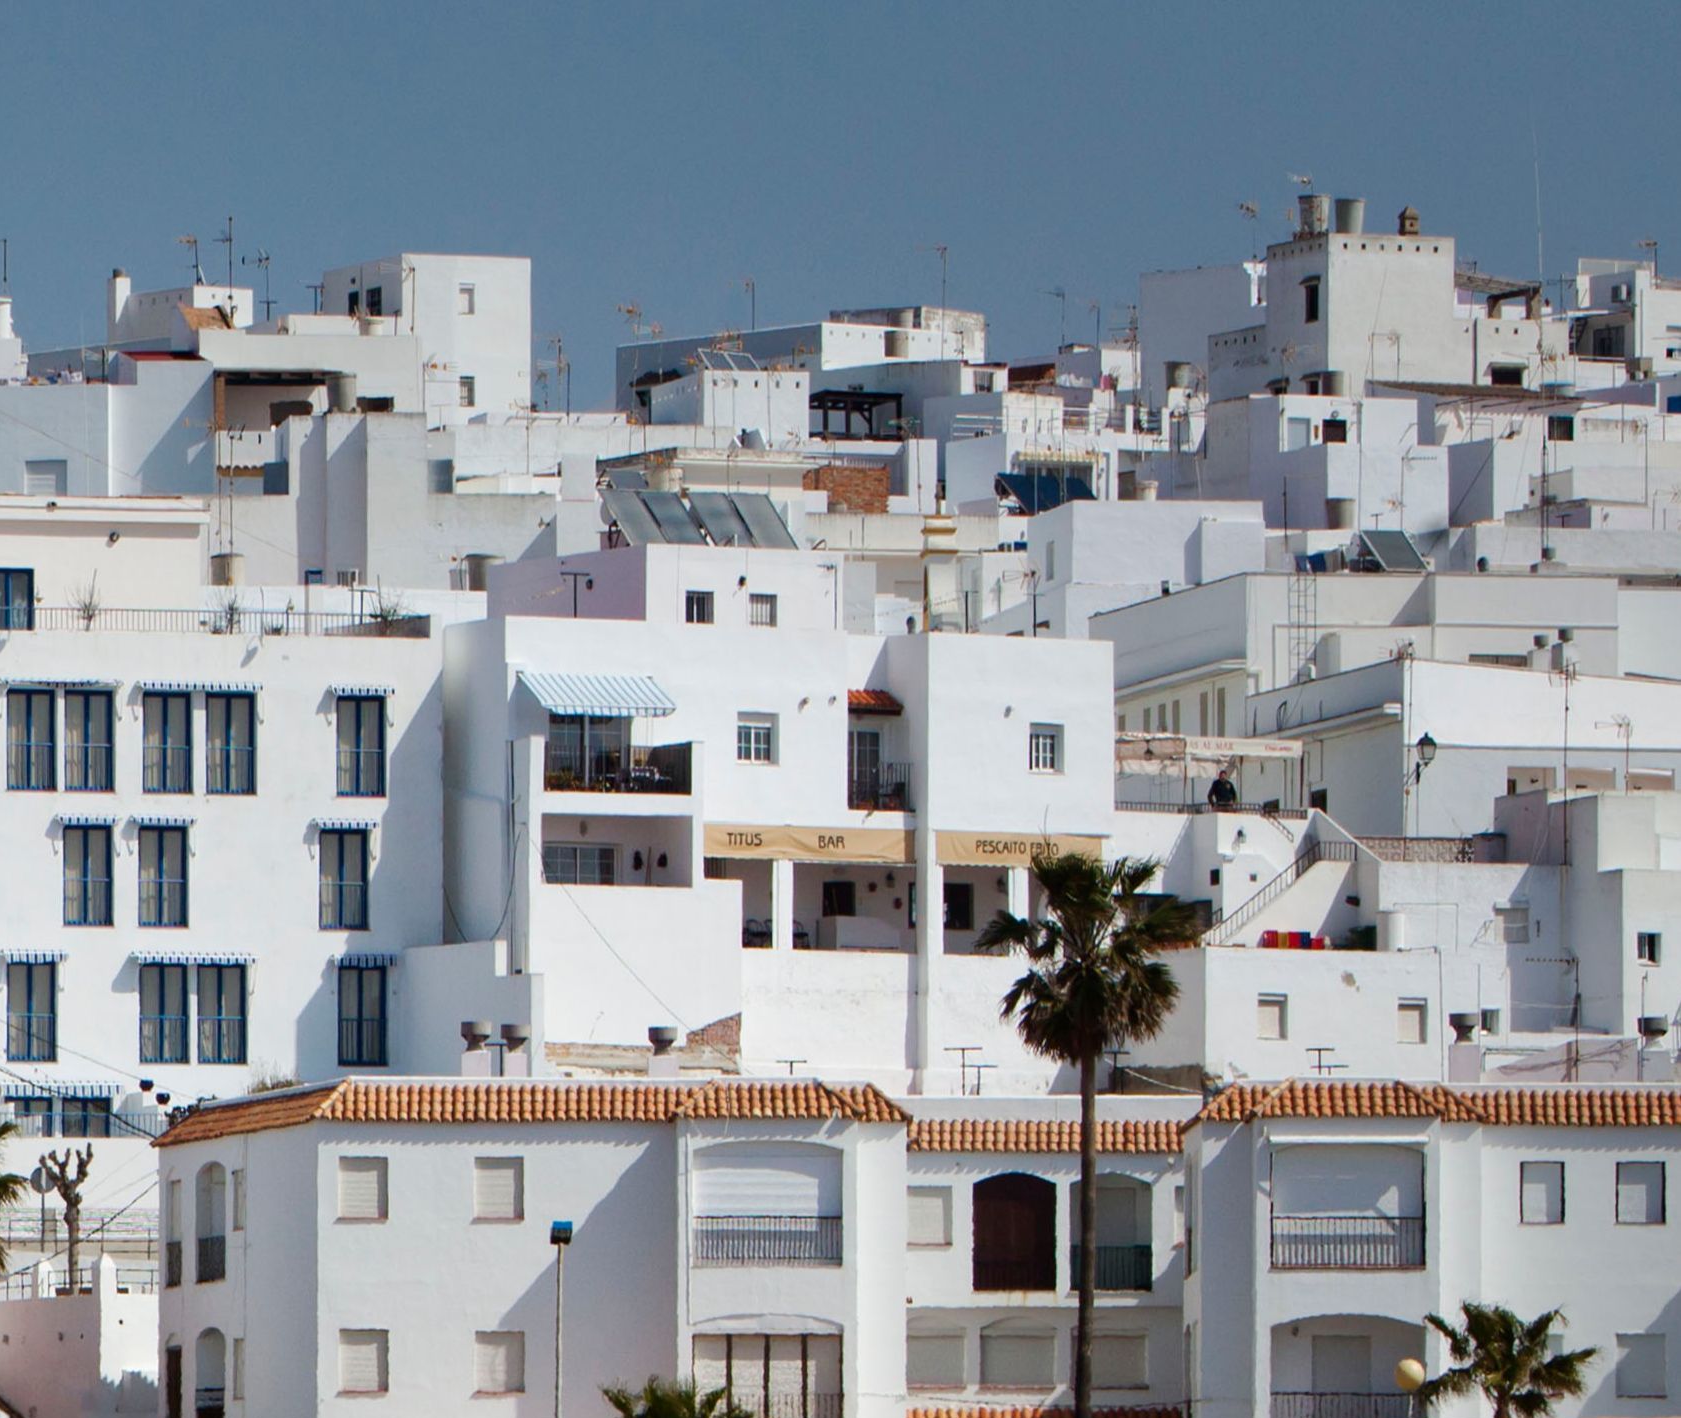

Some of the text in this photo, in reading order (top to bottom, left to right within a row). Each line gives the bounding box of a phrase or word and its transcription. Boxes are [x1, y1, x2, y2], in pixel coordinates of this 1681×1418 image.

[727, 832, 846, 849] TITUS BAR
[975, 840, 1027, 854] PESCAITO
